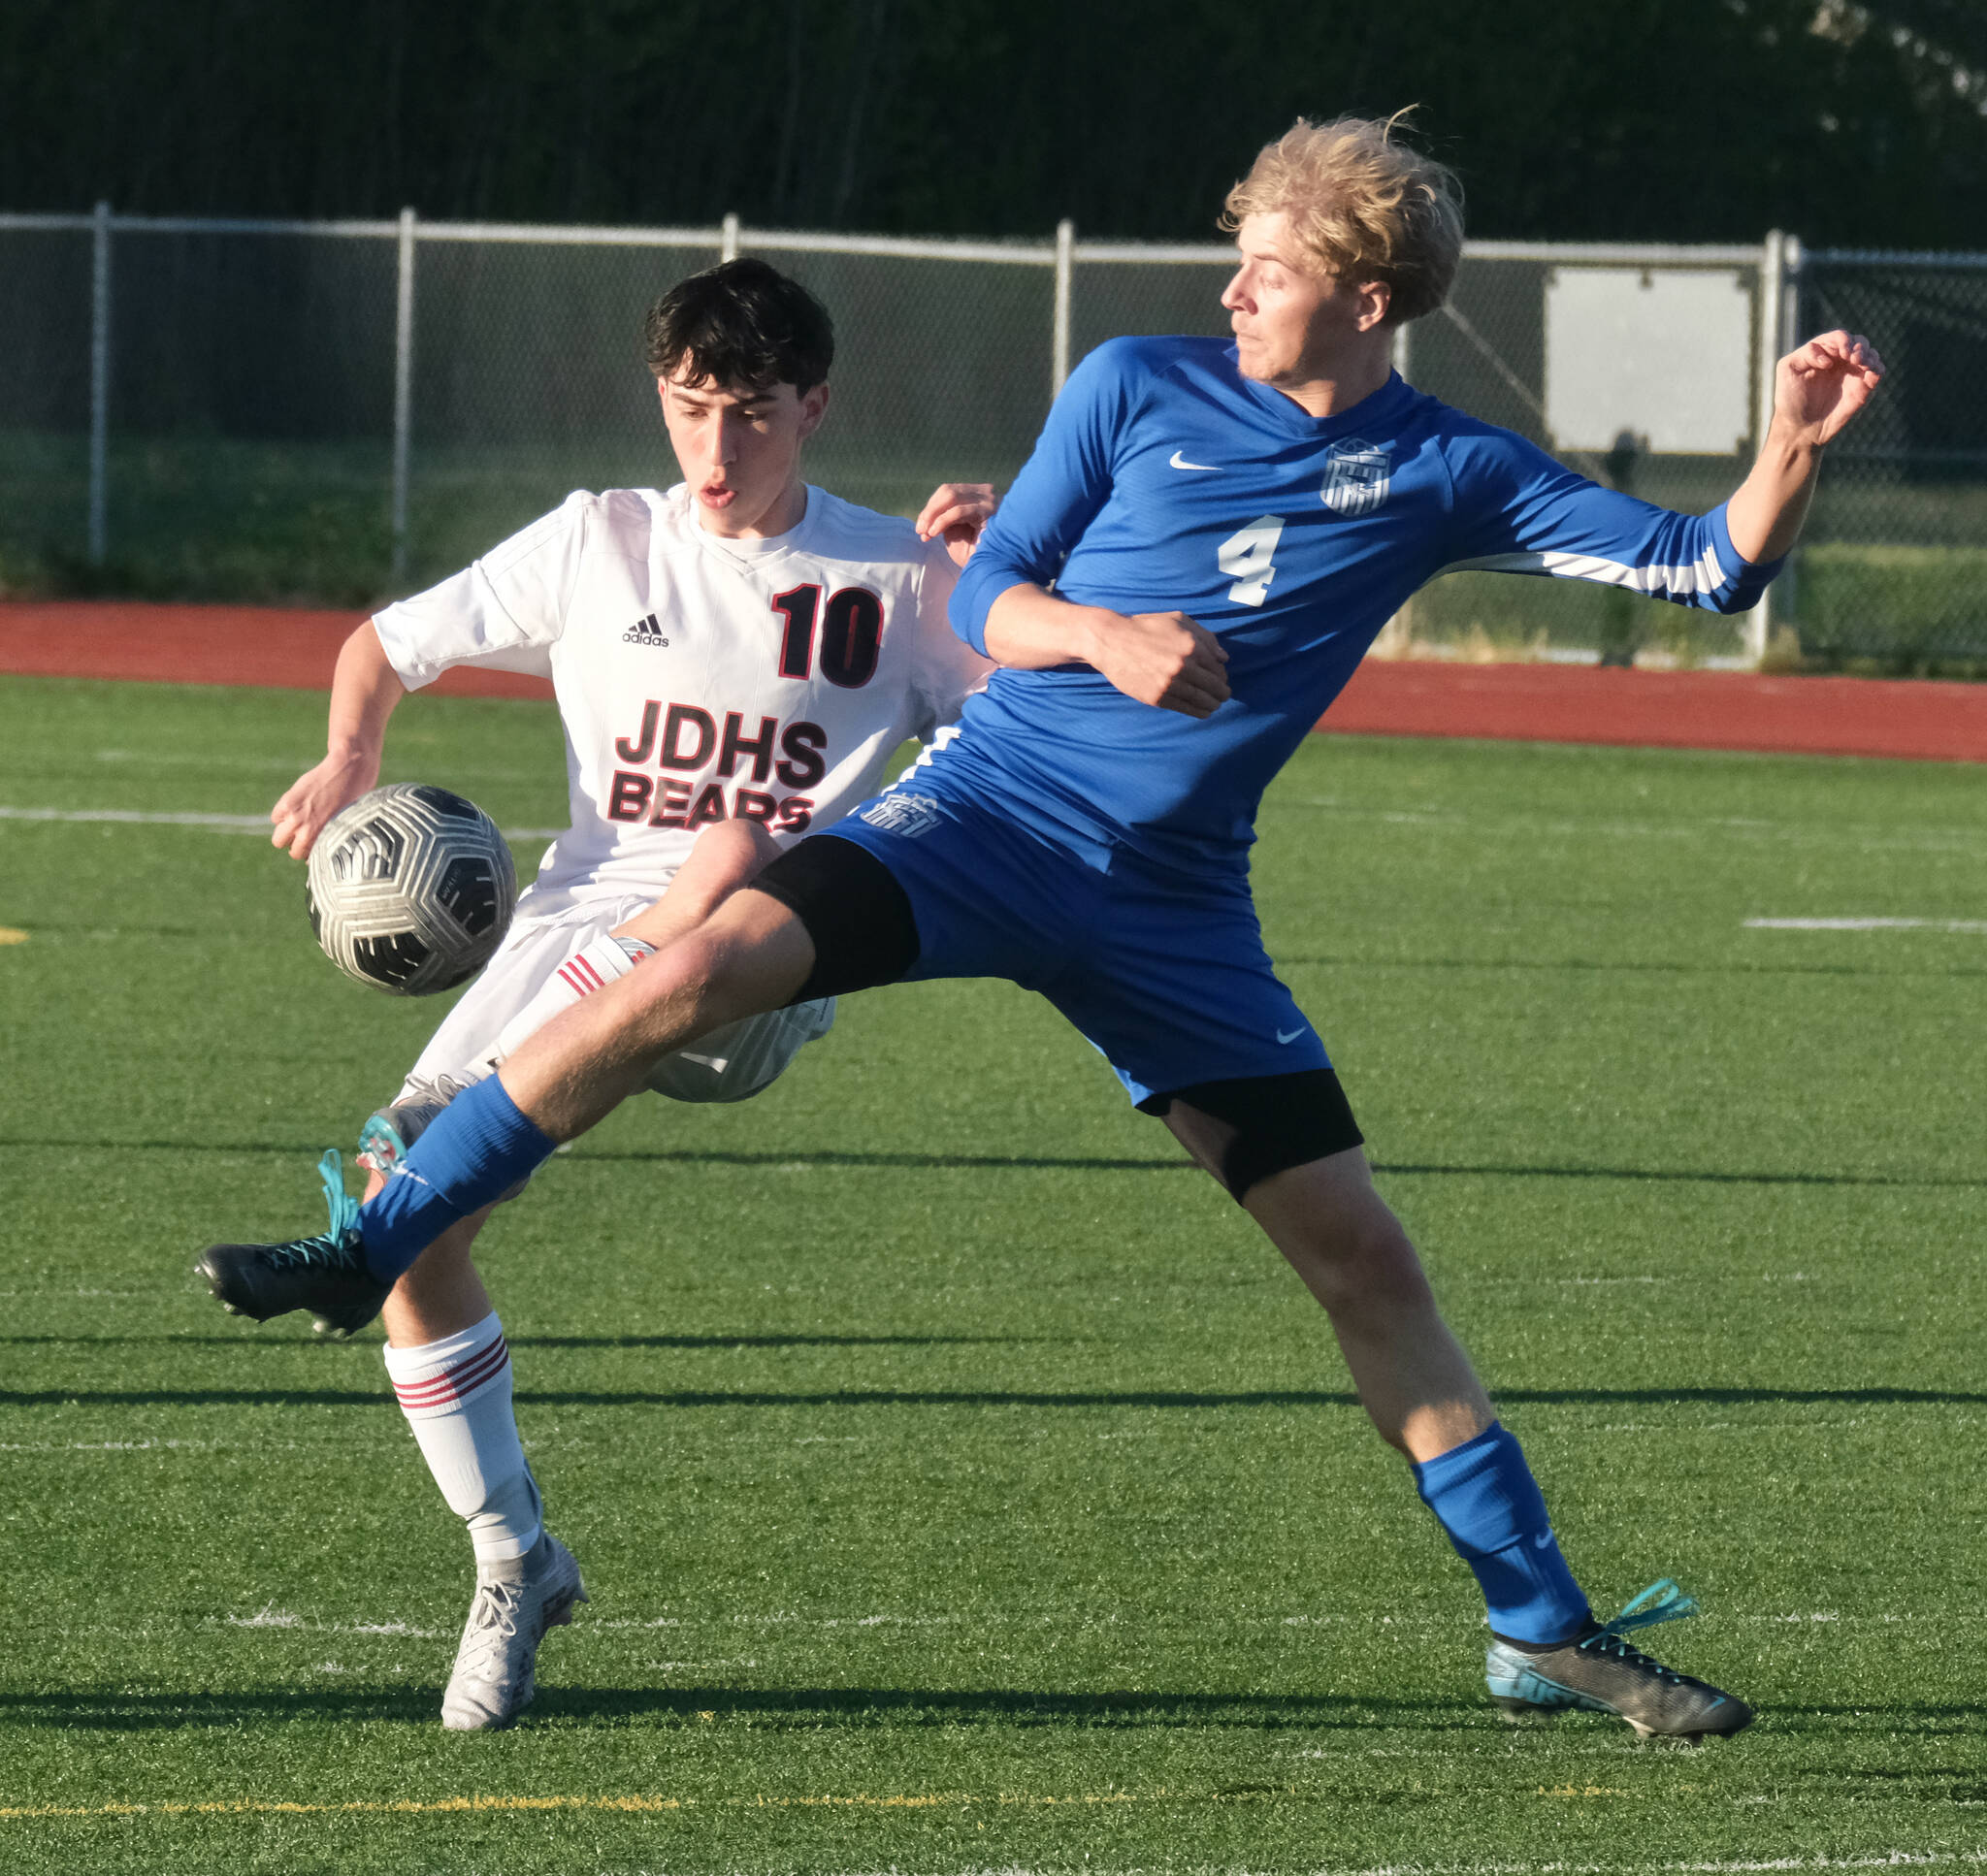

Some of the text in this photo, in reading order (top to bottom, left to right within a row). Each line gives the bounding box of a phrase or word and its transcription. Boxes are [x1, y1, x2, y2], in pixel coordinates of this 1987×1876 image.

[1218, 514, 1287, 607] 4
[622, 631, 669, 648] adidas
[771, 583, 885, 690] 10
[615, 699, 828, 791] JDHS
[607, 769, 815, 834] BEARS
